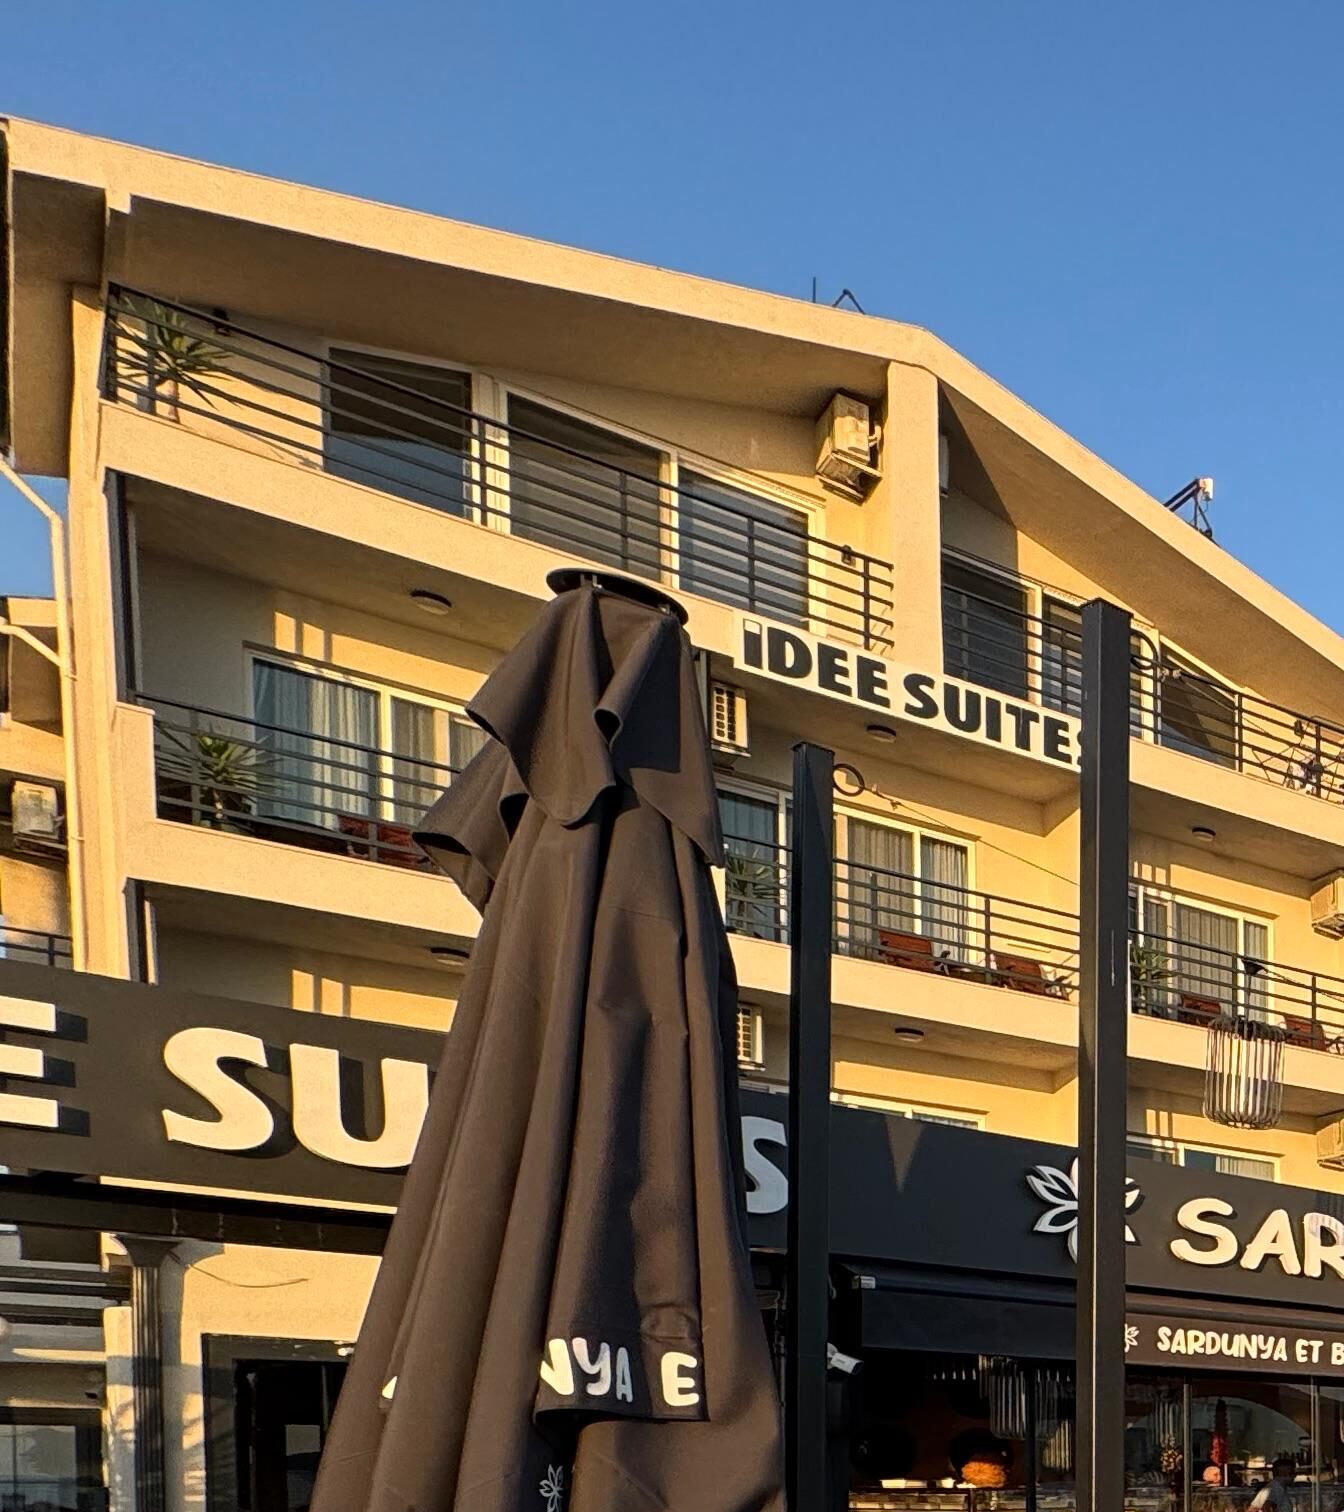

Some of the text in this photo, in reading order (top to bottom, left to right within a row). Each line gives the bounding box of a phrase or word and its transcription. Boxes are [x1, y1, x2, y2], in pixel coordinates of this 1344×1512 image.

[903, 672, 1082, 767] SUITE
[1157, 1326, 1288, 1362] SARDUNYA
[1296, 1339, 1324, 1364] ET
